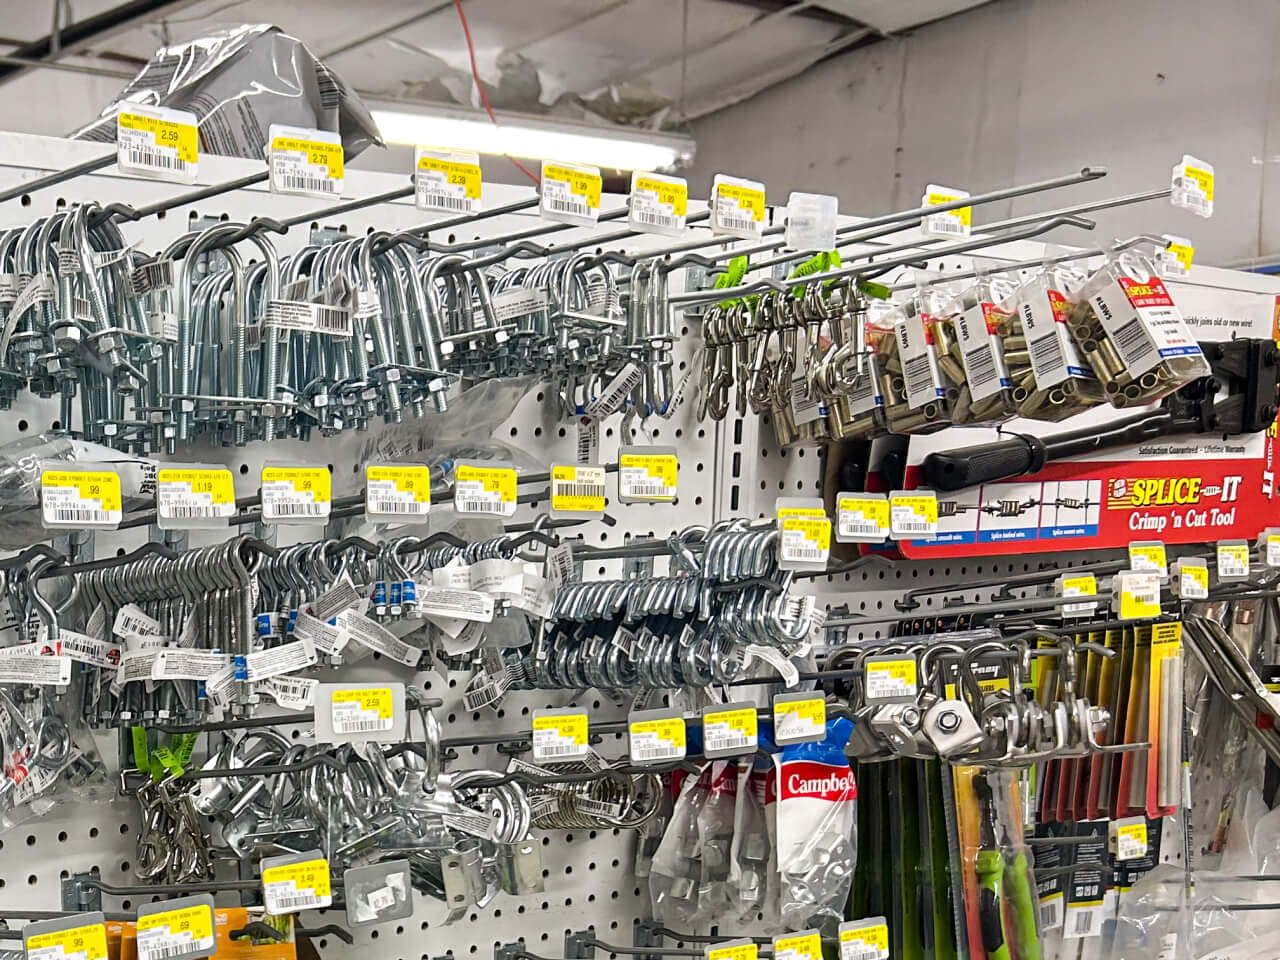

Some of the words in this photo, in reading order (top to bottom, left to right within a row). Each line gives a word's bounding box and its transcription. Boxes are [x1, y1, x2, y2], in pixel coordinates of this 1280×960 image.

[161, 129, 178, 140] 2.59
[312, 153, 328, 164] 2.79
[452, 175, 466, 184] 2.39
[1183, 318, 1198, 327] uickly
[196, 482, 212, 492] 1.19
[1131, 477, 1201, 506] SPLICE
[1129, 511, 1167, 530] Crimp
[1184, 509, 1206, 527] Cut
[1210, 508, 1236, 526] Tool
[787, 773, 855, 795] Campbe
